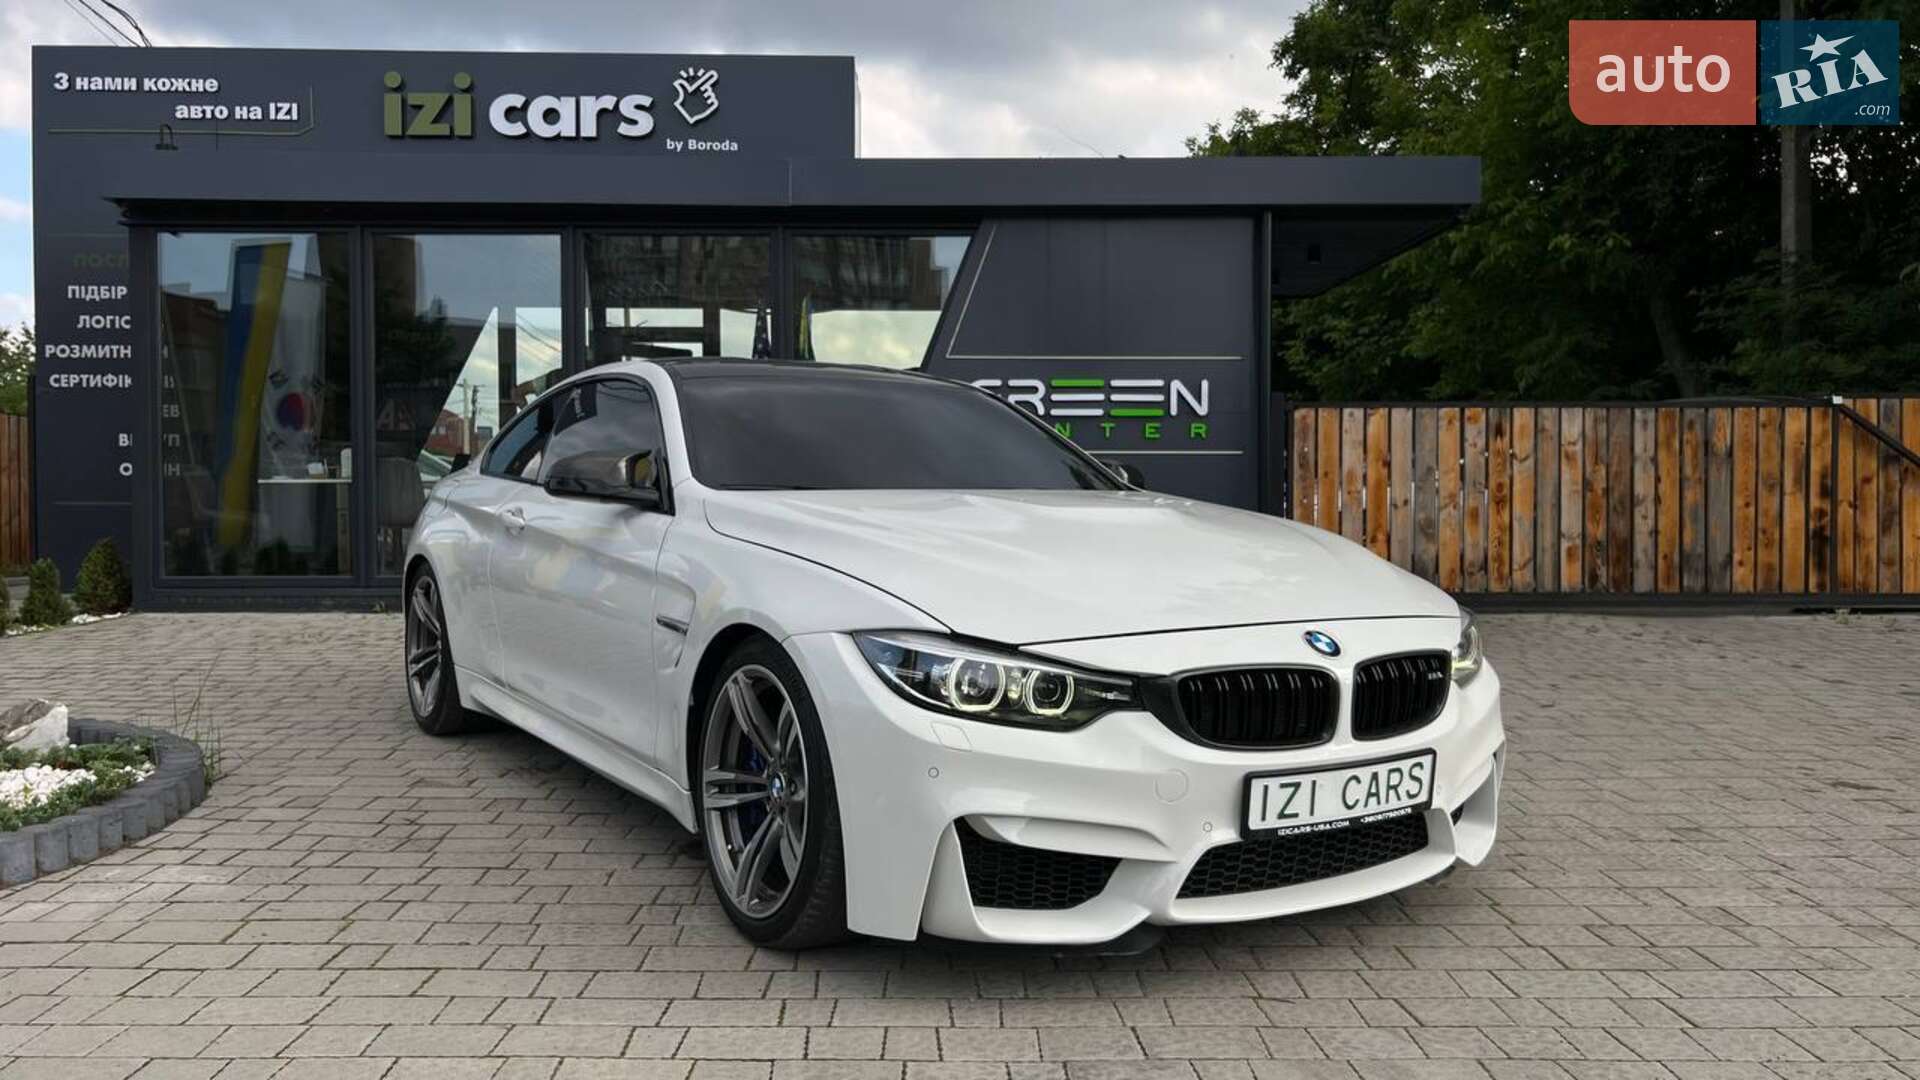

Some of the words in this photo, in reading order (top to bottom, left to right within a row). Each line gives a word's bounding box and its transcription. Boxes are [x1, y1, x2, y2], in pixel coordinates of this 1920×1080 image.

[53, 72, 70, 91] З
[75, 75, 138, 91] нами
[143, 76, 220, 93] кожне
[174, 103, 229, 120] авто
[234, 104, 263, 120] на
[269, 102, 299, 121] IZI
[384, 71, 473, 137] izi
[488, 93, 656, 139] cars
[666, 138, 683, 152] by
[687, 139, 739, 152] Boroda
[67, 284, 129, 302] ПІДБІР
[1260, 779, 1317, 823] IZI
[1341, 761, 1425, 811] CARS
